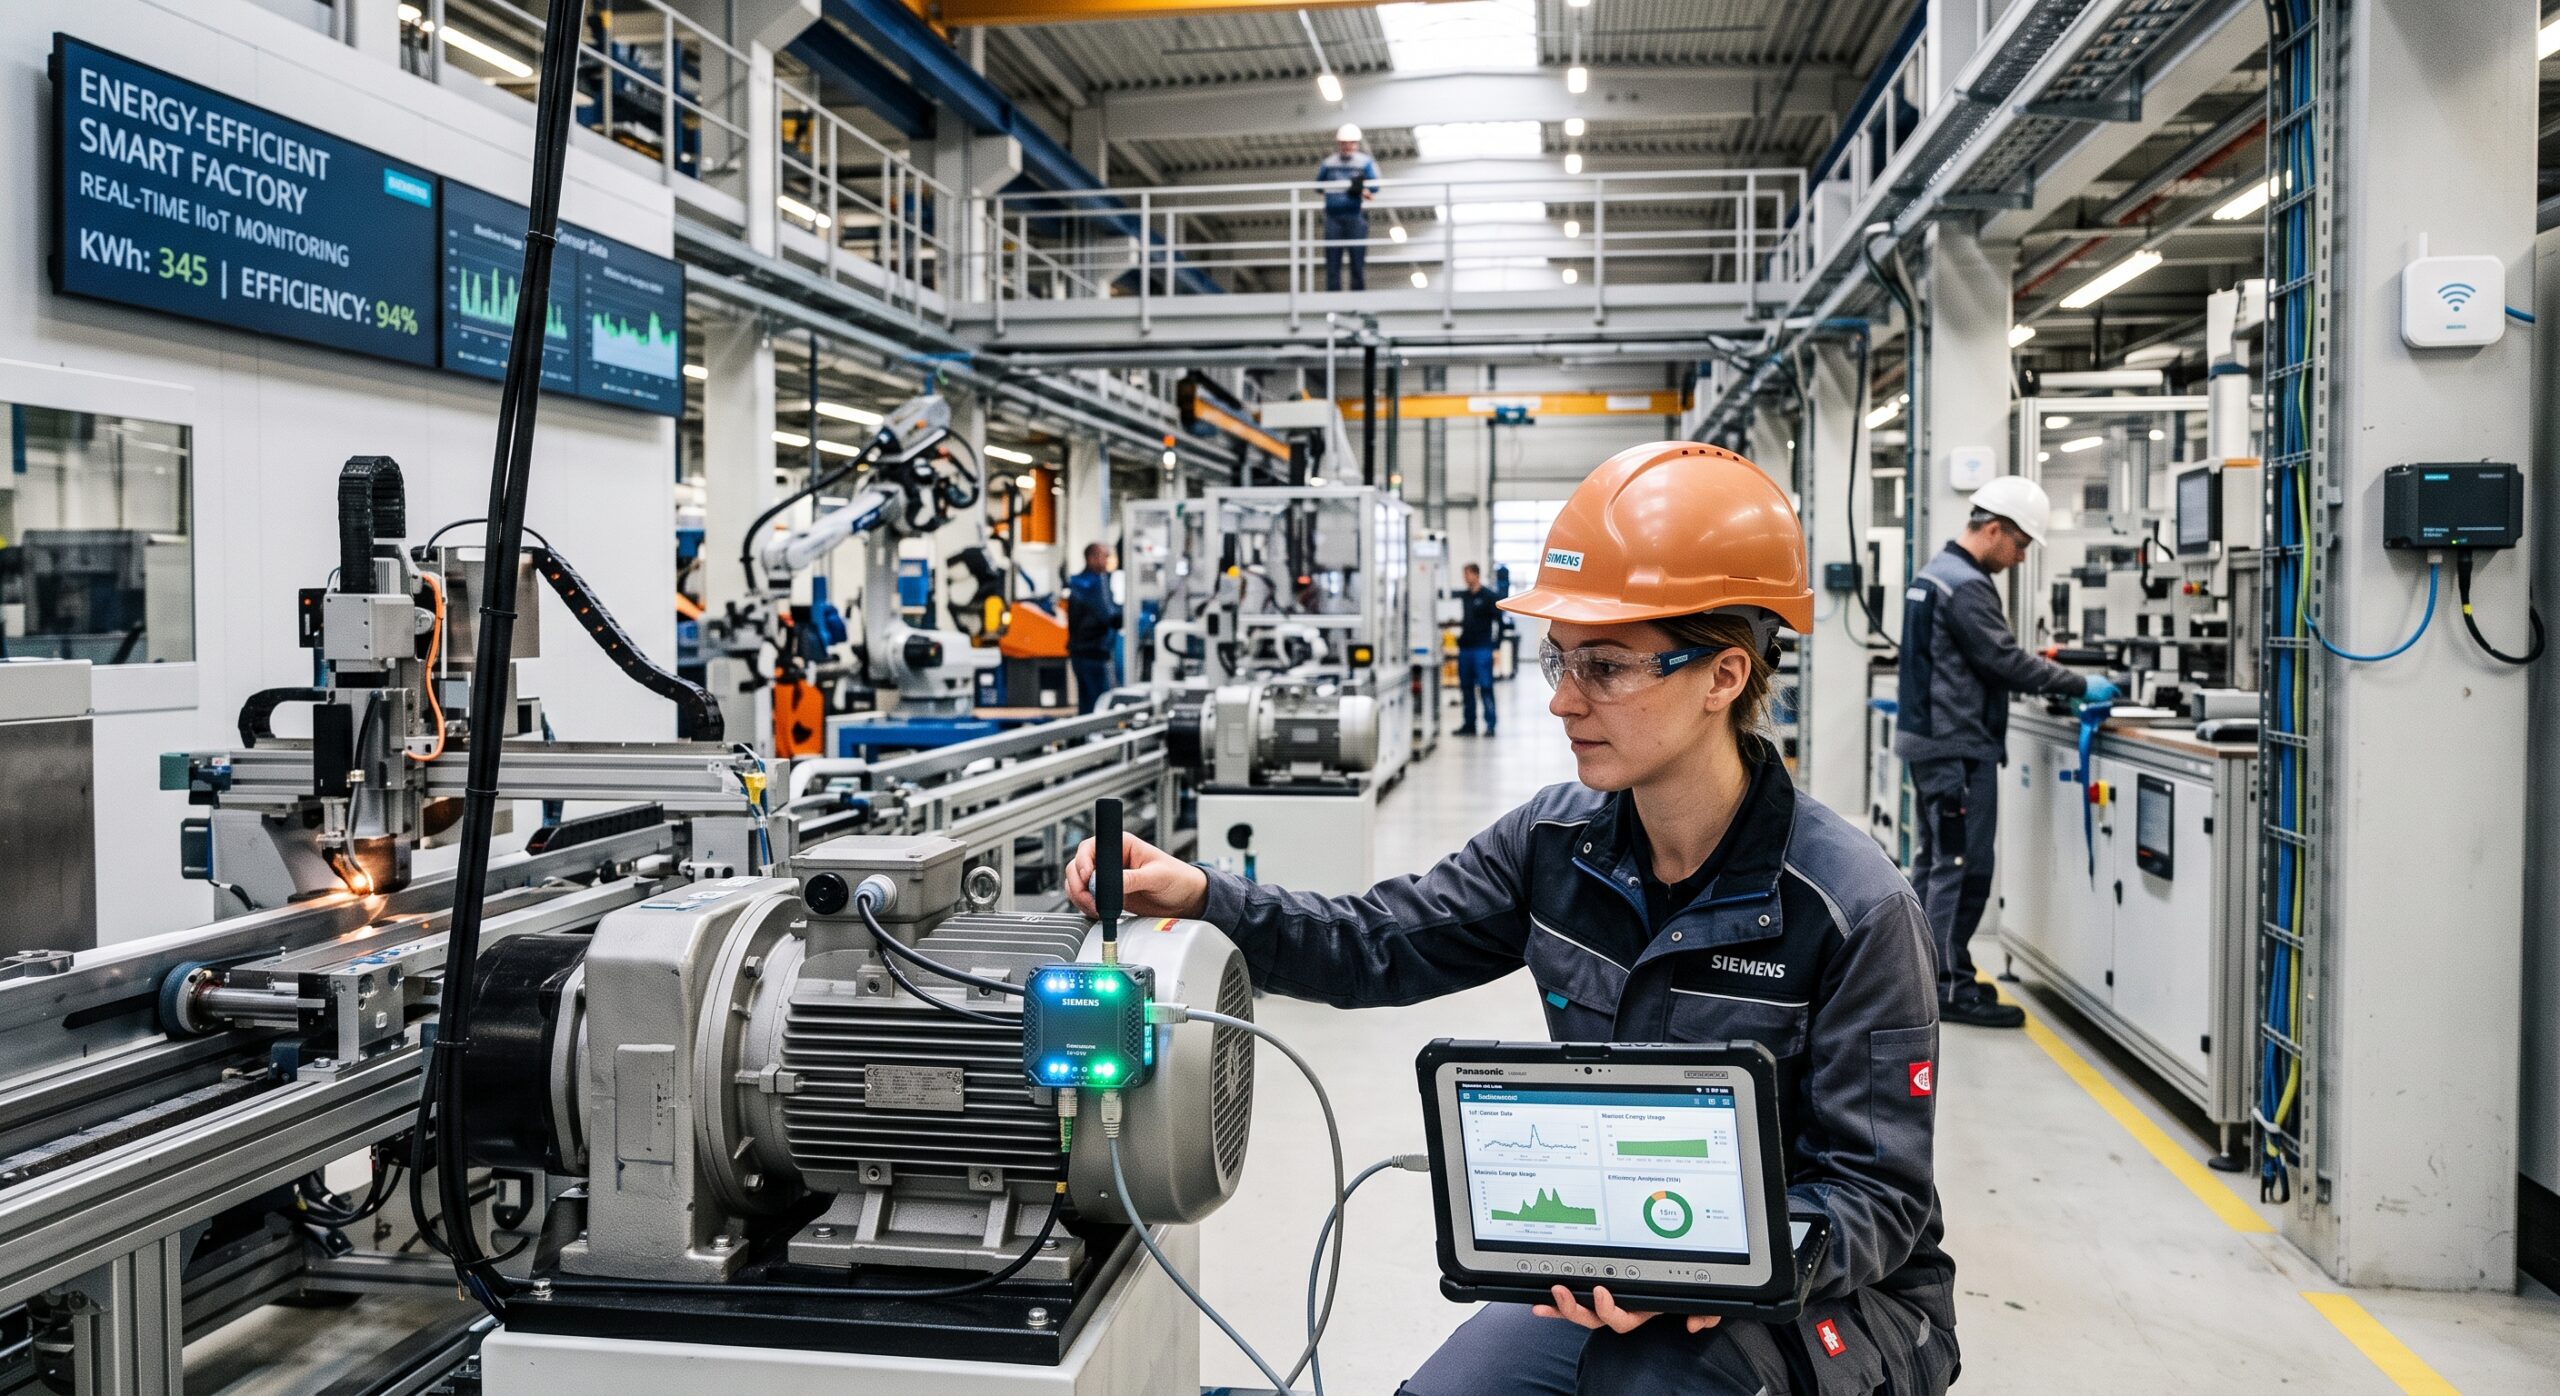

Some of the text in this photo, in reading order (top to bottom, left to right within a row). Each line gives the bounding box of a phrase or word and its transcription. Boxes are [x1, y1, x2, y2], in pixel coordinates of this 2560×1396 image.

[79, 117, 308, 215] SMART FACTORY
[80, 67, 331, 181] ENERGY-EFFICIENT
[80, 171, 190, 224] REAL-TIME
[235, 214, 350, 268] MONITORING
[80, 227, 151, 274] KWh:
[158, 246, 208, 287] 345
[241, 267, 371, 325] EFFICIENCY:
[375, 300, 418, 336] 94%
[1062, 998, 1100, 1007] SIEMENS
[1711, 954, 1786, 979] SIEMENS
[1455, 1067, 1504, 1076] Panasonic
